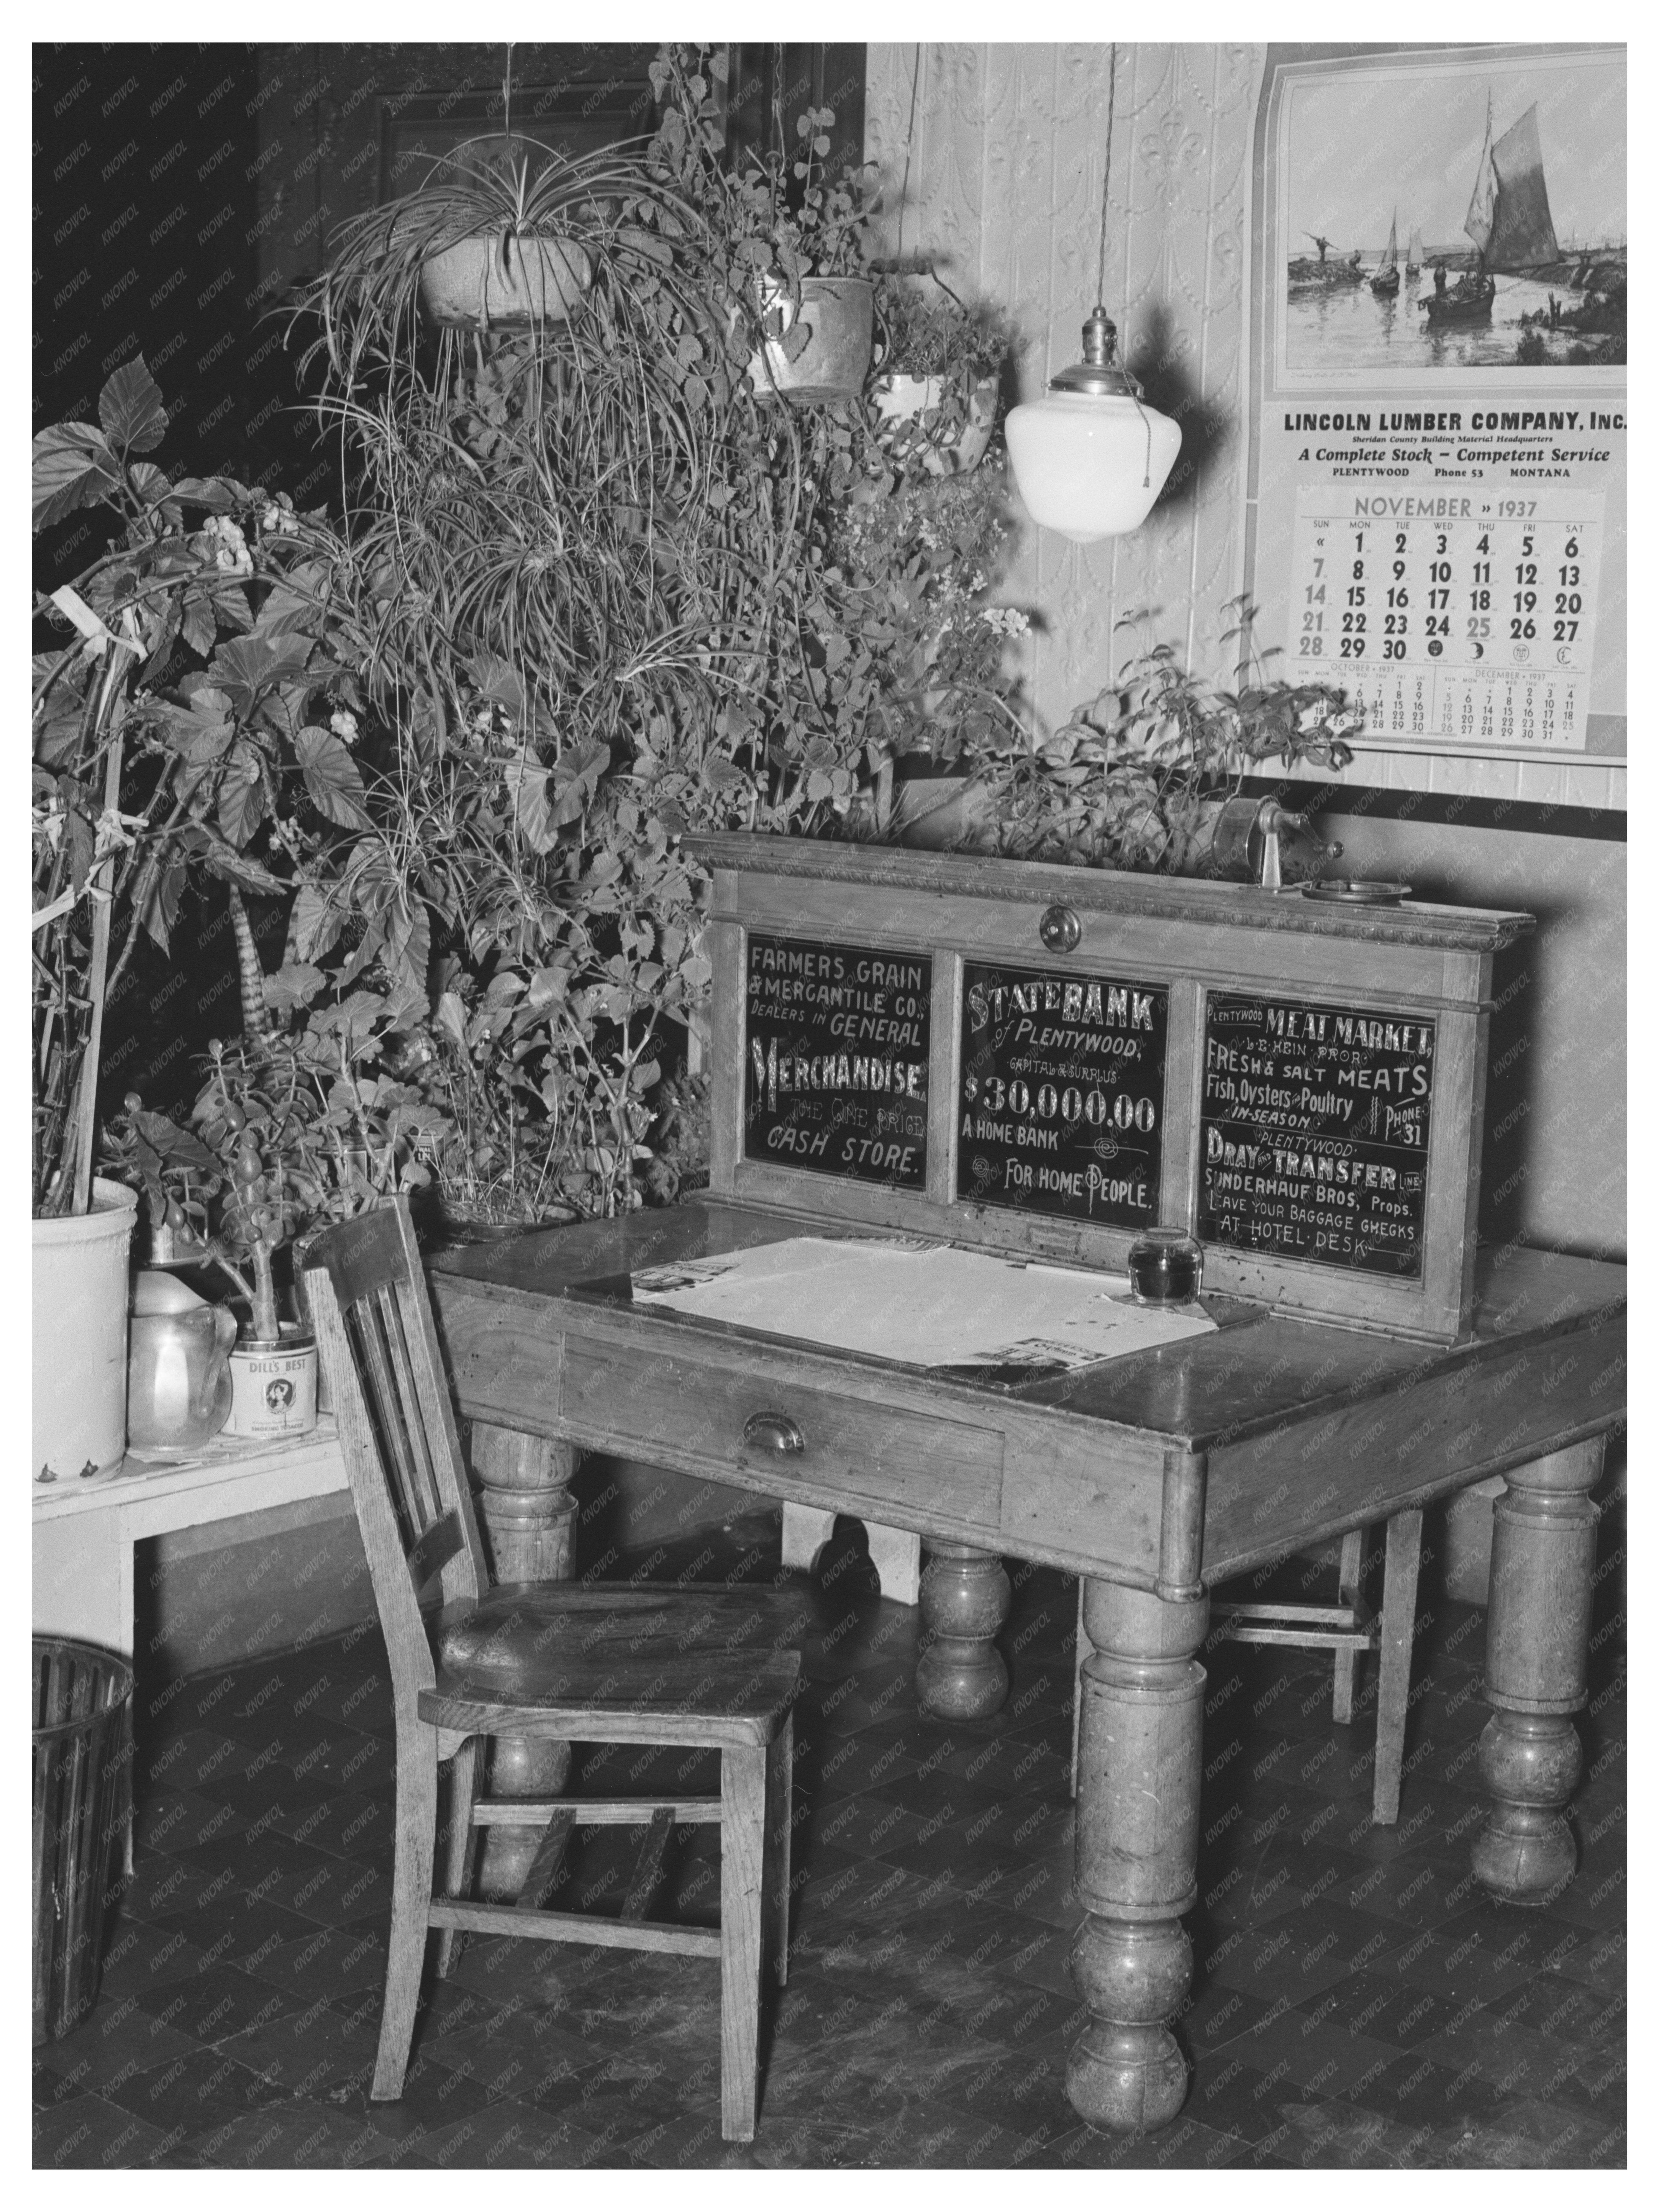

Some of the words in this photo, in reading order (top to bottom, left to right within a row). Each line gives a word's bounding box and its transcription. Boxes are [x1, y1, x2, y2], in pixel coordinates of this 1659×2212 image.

[1285, 413, 1370, 431] LINCOLN
[1379, 413, 1461, 431] LUMBER
[1471, 412, 1584, 431] COMPANY,
[1590, 412, 1627, 430] Inc.
[1389, 436, 1418, 444] County
[1421, 436, 1455, 444] Building
[1496, 435, 1553, 444] Headquarters
[1298, 448, 1309, 461] A
[1316, 448, 1386, 464] Complete
[1392, 448, 1433, 464] Stock
[1457, 448, 1544, 464] Competent
[1551, 448, 1610, 461] Service
[1333, 467, 1409, 477] PLENTYWOOD
[1434, 468, 1467, 477] Phone
[1472, 469, 1484, 478] 53
[1510, 468, 1570, 477] MONTANA
[1355, 497, 1471, 517] NOVEMBER
[1498, 500, 1537, 517] 1937
[1313, 520, 1329, 528] SUN
[1349, 521, 1370, 529] MON
[1396, 521, 1410, 530] TUE
[1434, 522, 1453, 530] WED
[1478, 522, 1495, 531] THU
[1523, 523, 1536, 532] FRI
[1566, 524, 1584, 533] SAT
[1355, 532, 1363, 553] 1
[1395, 533, 1407, 553] 2
[1436, 534, 1447, 555] 3
[1476, 534, 1490, 555] 4
[1521, 536, 1534, 557] 5
[1565, 536, 1579, 558] 6
[1313, 558, 1325, 578] 7
[1352, 560, 1364, 580] 8
[1392, 560, 1405, 581] 9
[1429, 562, 1452, 583] 10
[1473, 562, 1490, 583] 11
[1515, 563, 1537, 585] 12
[1559, 565, 1580, 587] 13
[1305, 584, 1326, 605] 14
[1347, 586, 1366, 607] 15
[1387, 587, 1409, 608] 16
[1428, 589, 1450, 610] 17
[1470, 590, 1490, 611] 18
[1513, 591, 1537, 613] 19
[1555, 593, 1582, 614] 20
[1302, 611, 1323, 632] 21
[1342, 612, 1367, 633] 22
[1384, 614, 1408, 635] 23
[1425, 615, 1450, 636] 24
[1467, 617, 1490, 638] 25
[1510, 618, 1536, 639] 26
[1553, 620, 1579, 642] 27
[1299, 636, 1323, 656] 28
[1340, 638, 1366, 658] 29
[1383, 639, 1407, 660] 30
[1331, 662, 1370, 672] OCTOBER
[1475, 669, 1520, 680] DECEMBER
[1463, 704, 1472, 713] 13
[1484, 706, 1493, 714] 14
[1503, 707, 1513, 716] 15
[1524, 708, 1533, 717] 16
[1544, 710, 1554, 718] 17
[1564, 711, 1573, 720] 18
[1465, 694, 1472, 703] 6
[1487, 695, 1492, 704] 7
[1506, 697, 1512, 705] 8
[1526, 698, 1533, 707] 9
[1545, 699, 1554, 708] 10
[1566, 701, 1574, 710] 11
[1461, 714, 1474, 724] 20
[1482, 716, 1492, 725] 21
[1502, 717, 1514, 727] 22
[1522, 718, 1534, 728] 23
[1543, 720, 1554, 729] 24
[1461, 725, 1473, 734] 27
[1481, 726, 1493, 735] 28
[1501, 727, 1513, 737] 29
[1522, 729, 1534, 739] 30
[1543, 730, 1552, 740] 31
[752, 947, 844, 979] FARMERS
[857, 961, 921, 990] GRAIN
[765, 977, 885, 1013] MERCANTILE
[969, 982, 1061, 1033] STATE
[1062, 983, 1154, 1031] BANK
[751, 999, 805, 1022] DEALERS
[812, 1013, 826, 1025] IN
[830, 1013, 921, 1046] GENERAL
[995, 1020, 1014, 1048] of
[1207, 1004, 1262, 1022] PLENTYWOOD
[1266, 1008, 1330, 1040] MEAT
[1208, 1037, 1261, 1074] FRESH
[1283, 1065, 1326, 1082] SALT
[964, 1073, 1155, 1132] $30,000.00
[1240, 1079, 1291, 1108] Oysters
[1301, 1087, 1353, 1122] Poultry
[791, 1098, 822, 1120] THE
[832, 1097, 867, 1128] ONE
[876, 1108, 923, 1137] PRICE
[962, 1113, 972, 1137] A
[977, 1119, 1013, 1144] HOME
[1018, 1125, 1059, 1150] BANK
[1385, 1105, 1421, 1141] PHONE
[767, 1125, 829, 1155] CASH
[1403, 1123, 1421, 1145] 31
[1207, 1126, 1260, 1169] DRAY
[1272, 1149, 1396, 1190] TRANSFER
[1004, 1157, 1032, 1189] FOR
[1039, 1167, 1082, 1197] HOME
[1205, 1168, 1310, 1200] SUNDERHAUF
[1252, 1200, 1284, 1218] YOUR
[1290, 1204, 1354, 1230] BAGGAGE
[1251, 1220, 1305, 1245] HOTEL
[249, 1360, 280, 1373] DILL'S
[285, 1358, 306, 1372] BEST
